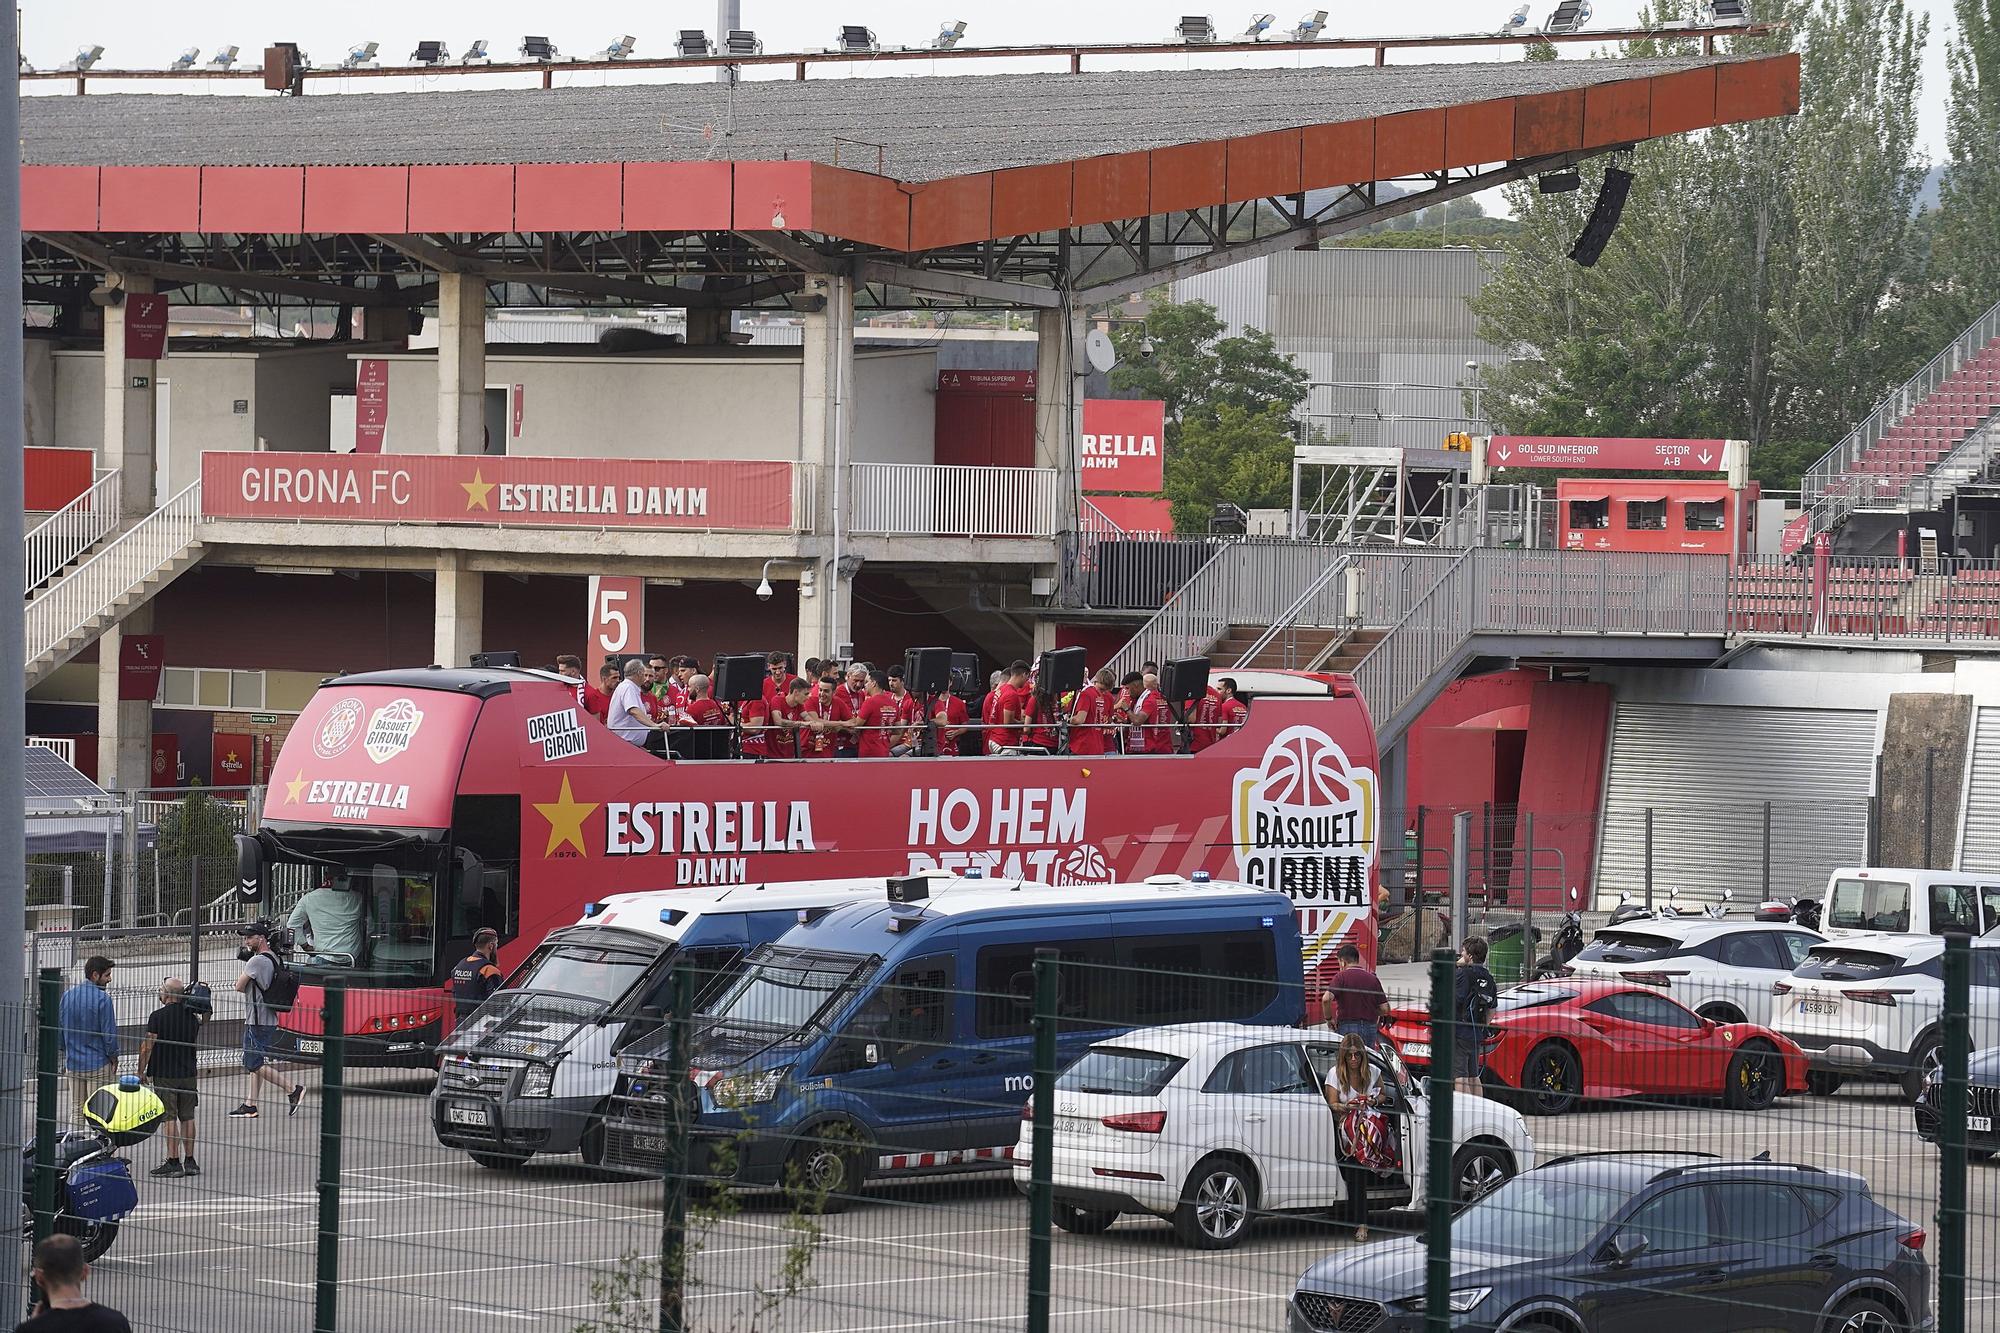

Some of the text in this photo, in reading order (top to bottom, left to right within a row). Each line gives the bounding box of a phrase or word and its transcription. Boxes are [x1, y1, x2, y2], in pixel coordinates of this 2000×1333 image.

[952, 374, 959, 382] A
[1026, 375, 1034, 384] A
[1518, 444, 1599, 455] GOL SUD INFERIOR
[1655, 445, 1690, 455] SECTOR
[1572, 456, 1586, 464] END
[1663, 457, 1681, 466] A-B
[241, 467, 411, 505] GIRONA FC
[499, 483, 708, 516] ESTRELLA DAMM
[1815, 536, 1823, 546] A
[600, 590, 628, 652] 5
[331, 700, 362, 715] GIRONA
[375, 718, 412, 732] BÀSQUET
[529, 711, 577, 740] ORGULL
[366, 731, 409, 748] GIRONA
[544, 727, 586, 758] GIRONÍ
[221, 760, 243, 768] Estrella
[306, 780, 410, 810] ESTRELLA
[332, 804, 369, 820] DAMM
[908, 788, 1088, 846] HO HEM
[604, 800, 817, 856] ESTRELLA
[1256, 806, 1358, 850] BÀSQUET
[676, 858, 748, 886] DAMM
[1246, 855, 1363, 907] GIRONA
[1804, 1002, 1839, 1015] 4599 LSV
[302, 1041, 319, 1052] 2396
[592, 1060, 616, 1070] policia
[800, 1081, 825, 1092] policia
[145, 1108, 158, 1120] 092
[1972, 1118, 1989, 1129] KTP
